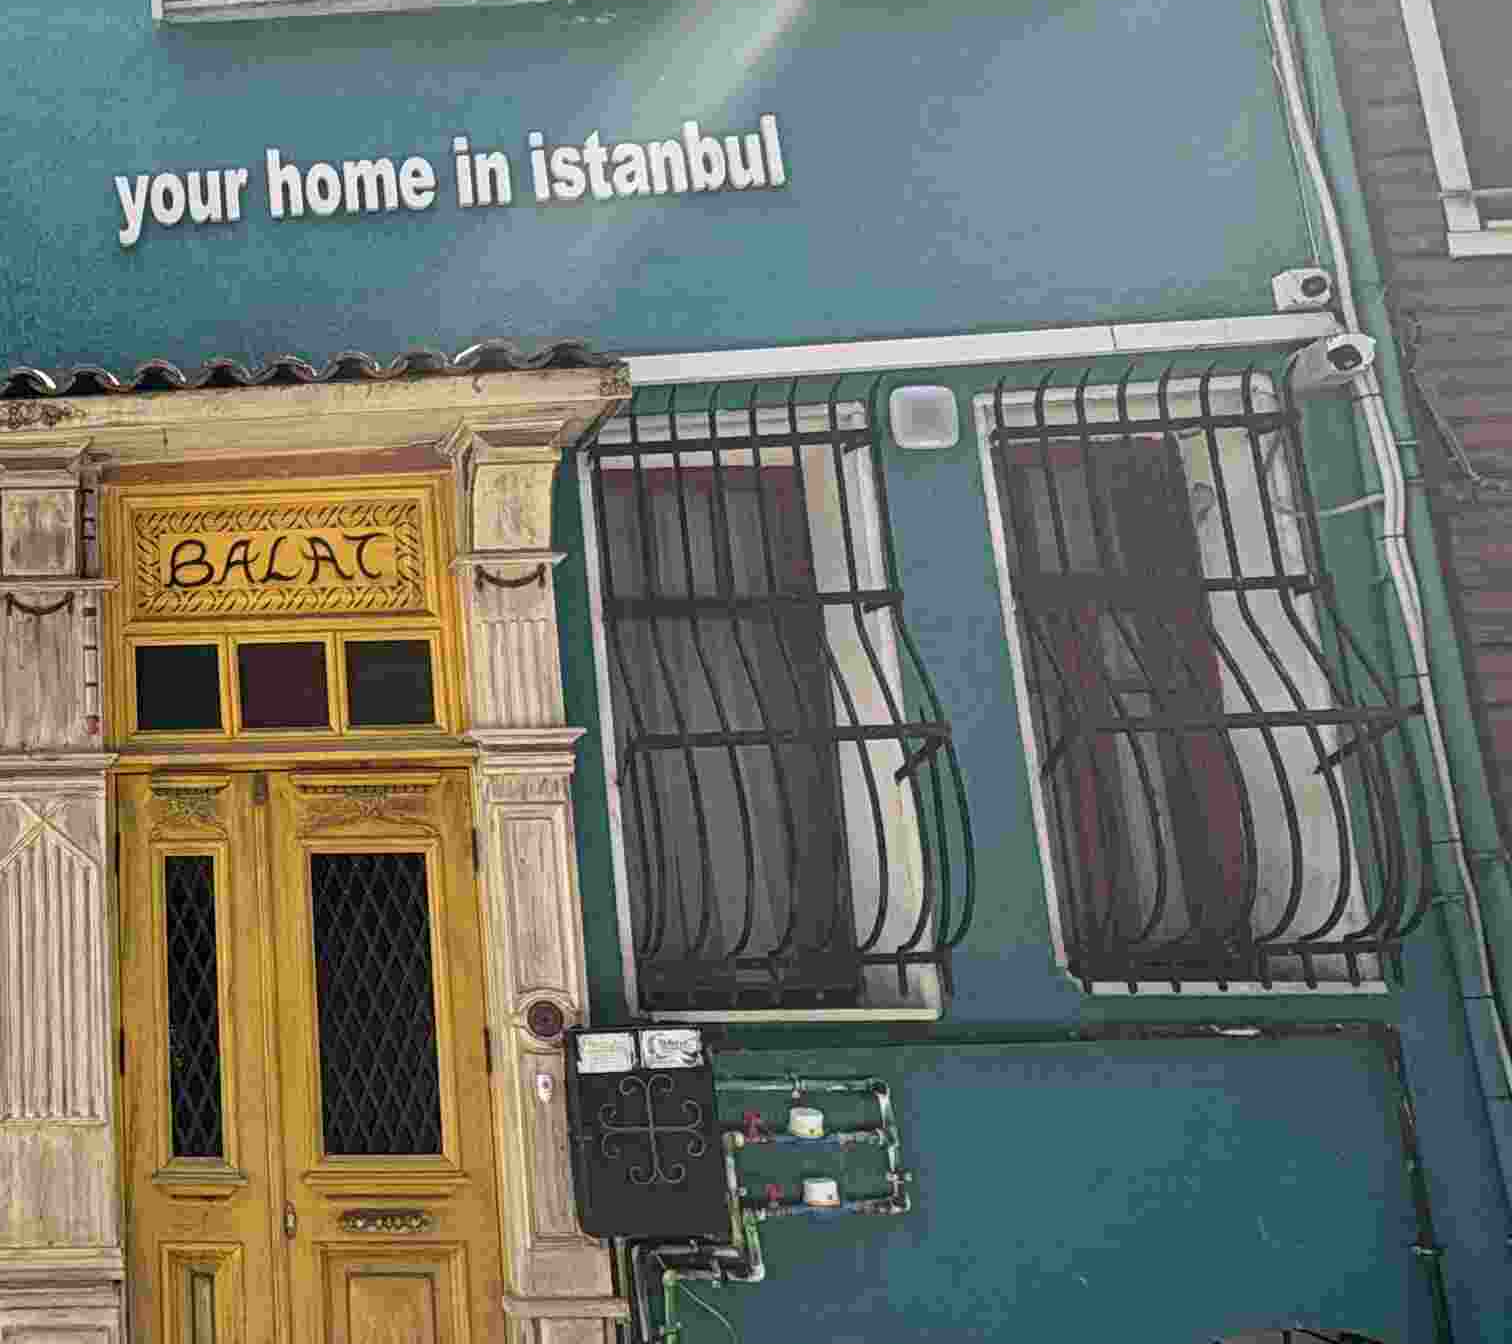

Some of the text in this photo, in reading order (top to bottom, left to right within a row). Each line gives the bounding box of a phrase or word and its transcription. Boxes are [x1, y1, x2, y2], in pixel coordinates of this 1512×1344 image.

[113, 113, 786, 246] your home in istanbul
[164, 532, 393, 589] BALAT
